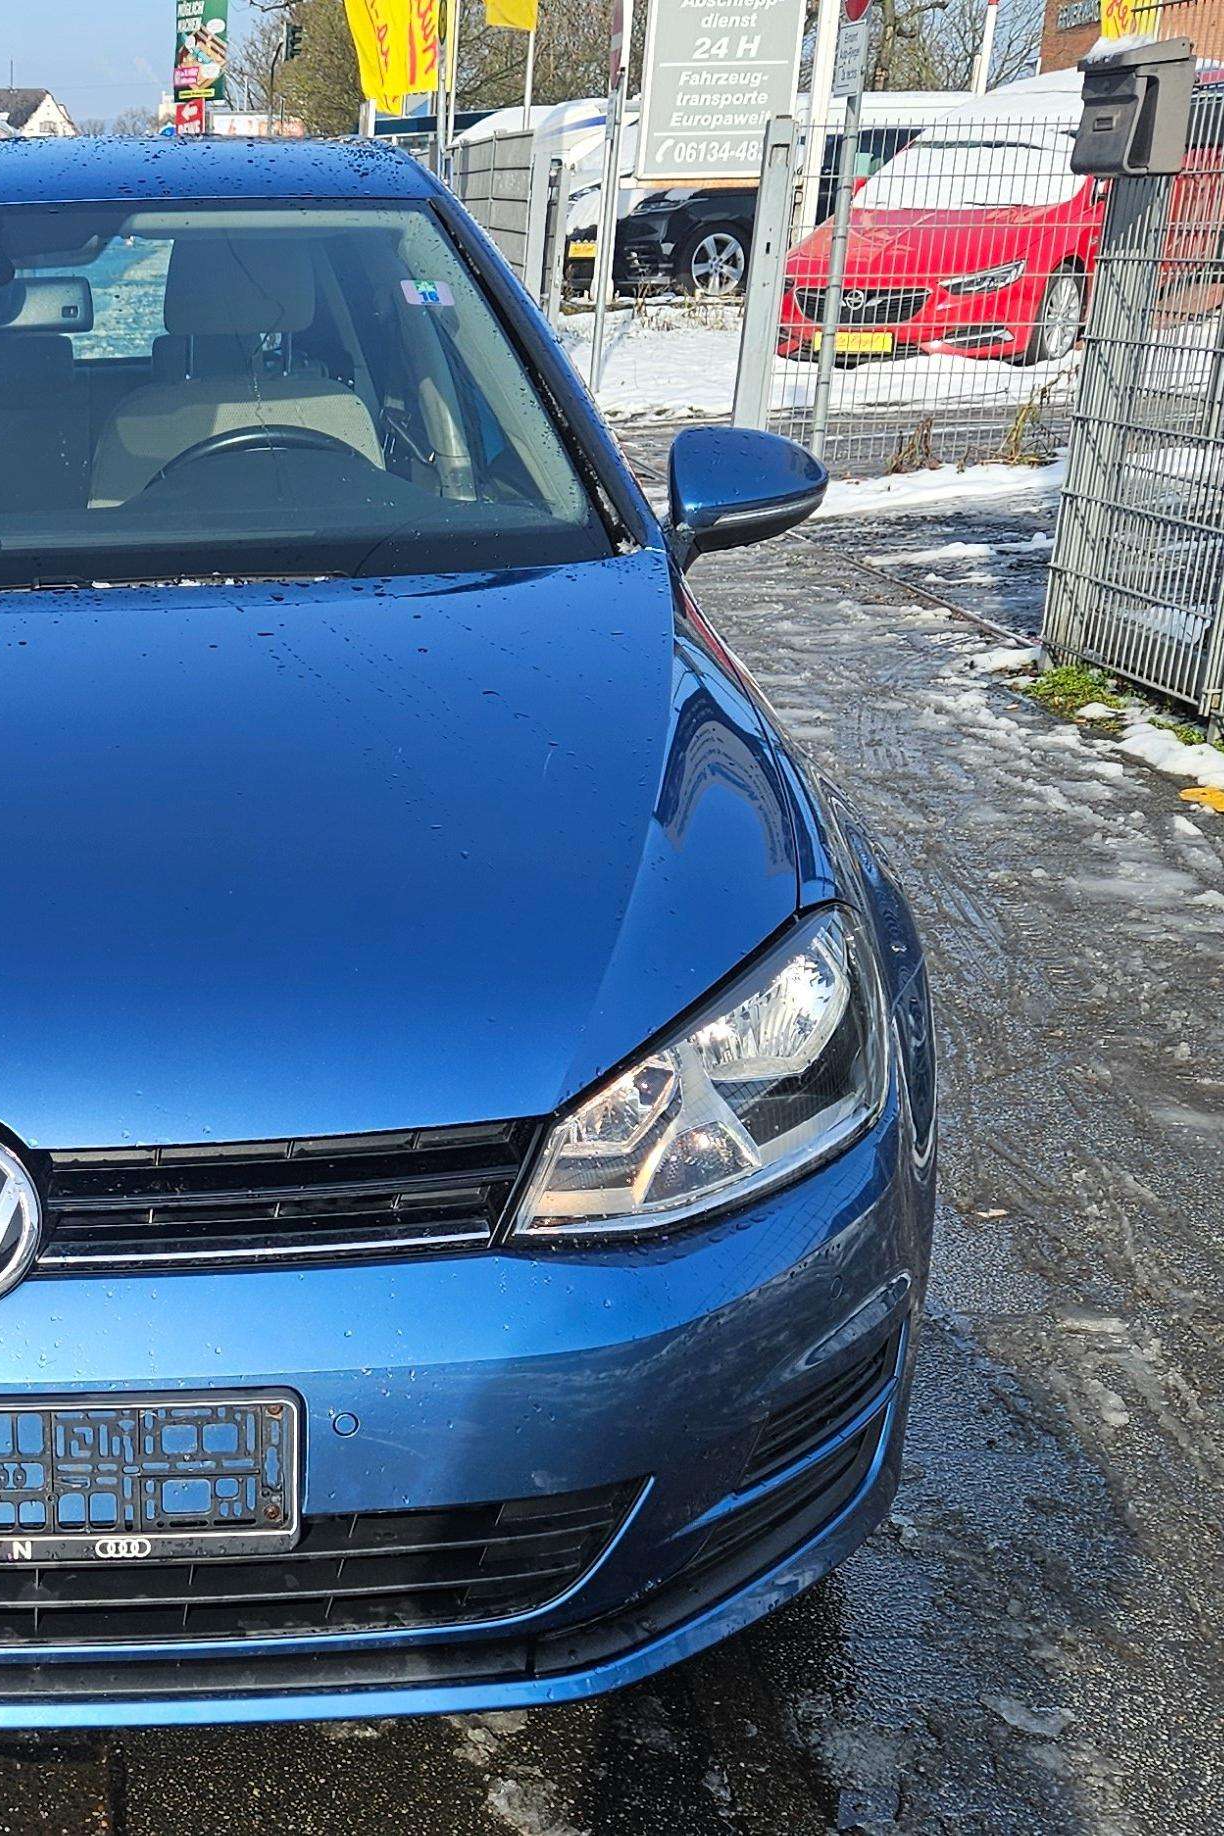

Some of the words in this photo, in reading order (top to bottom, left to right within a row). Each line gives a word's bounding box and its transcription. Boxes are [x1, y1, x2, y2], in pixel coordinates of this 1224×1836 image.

[701, 13, 757, 28] dienst
[692, 37, 729, 59] 24
[735, 35, 761, 58] H
[679, 71, 769, 87] Fahrzeug-
[676, 91, 768, 108] transporte
[670, 110, 771, 129] Europaweit
